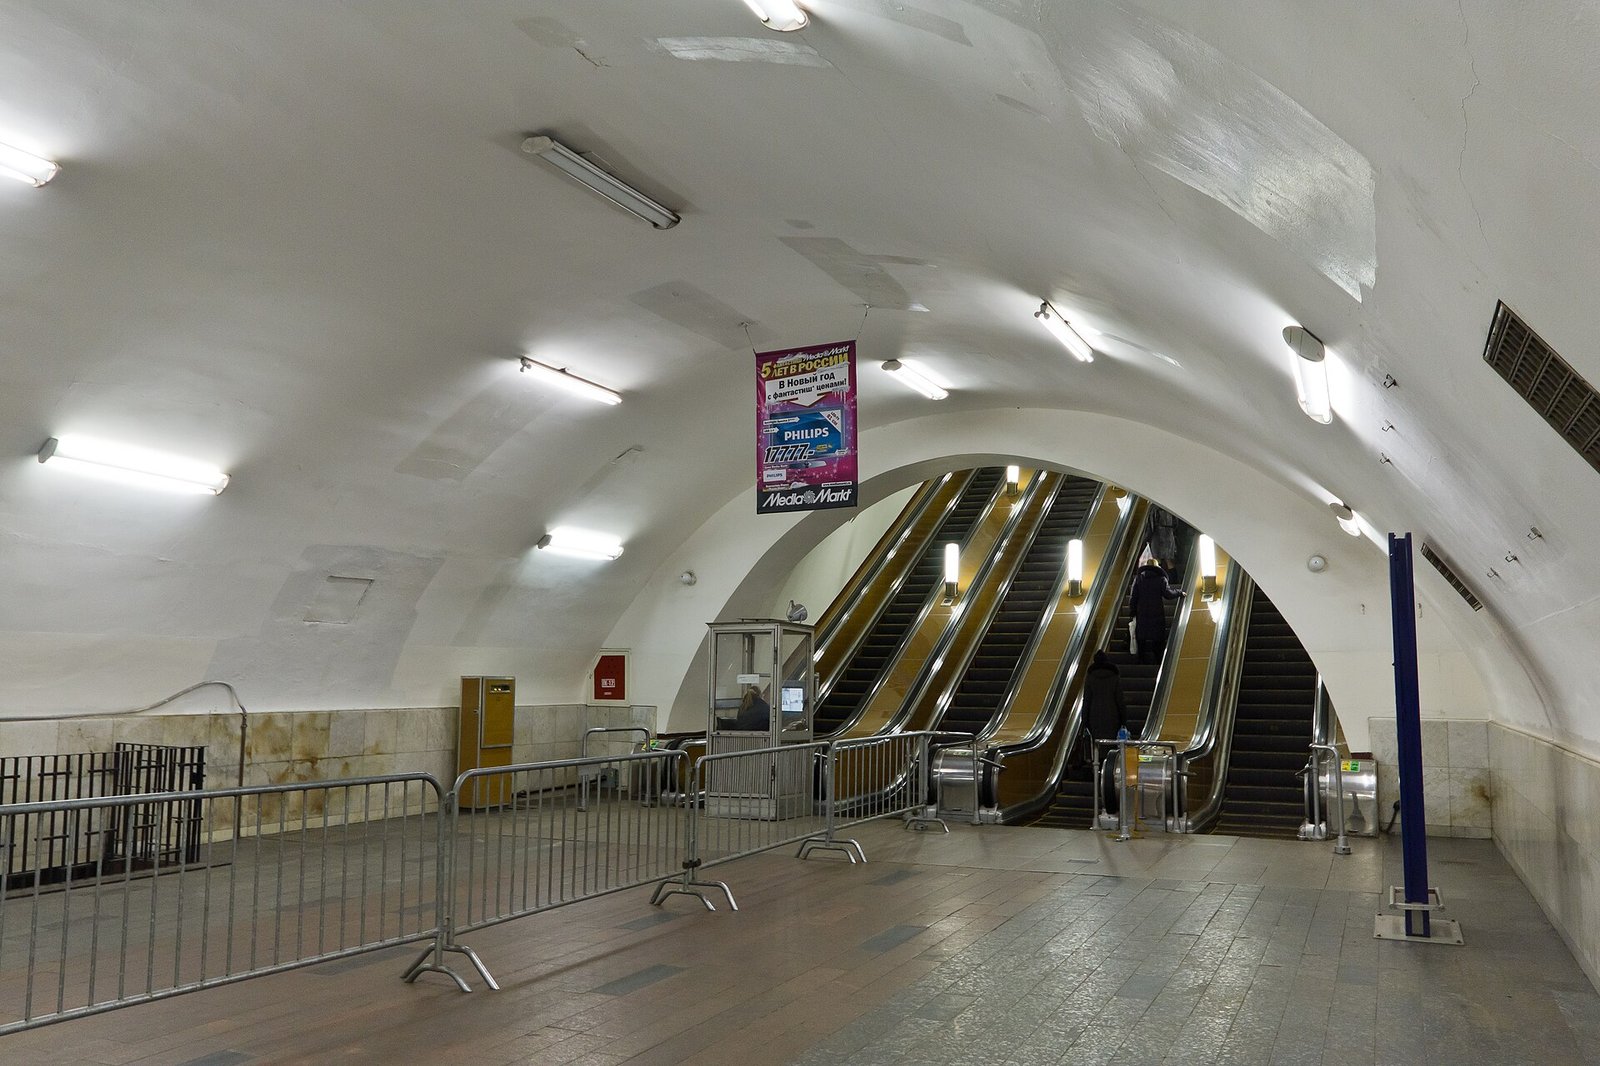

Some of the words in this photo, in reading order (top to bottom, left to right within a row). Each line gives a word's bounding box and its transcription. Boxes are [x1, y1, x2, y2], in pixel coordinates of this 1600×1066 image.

[760, 361, 773, 379] 5
[771, 366, 789, 378] ЛЕТ
[790, 364, 798, 374] В
[799, 352, 849, 373] РОССИИ
[779, 380, 785, 389] В
[787, 373, 818, 387] Новый
[816, 378, 847, 391] ценами!
[784, 427, 830, 441] PHILIPS
[762, 492, 804, 508] Media
[813, 488, 852, 504] Markt
